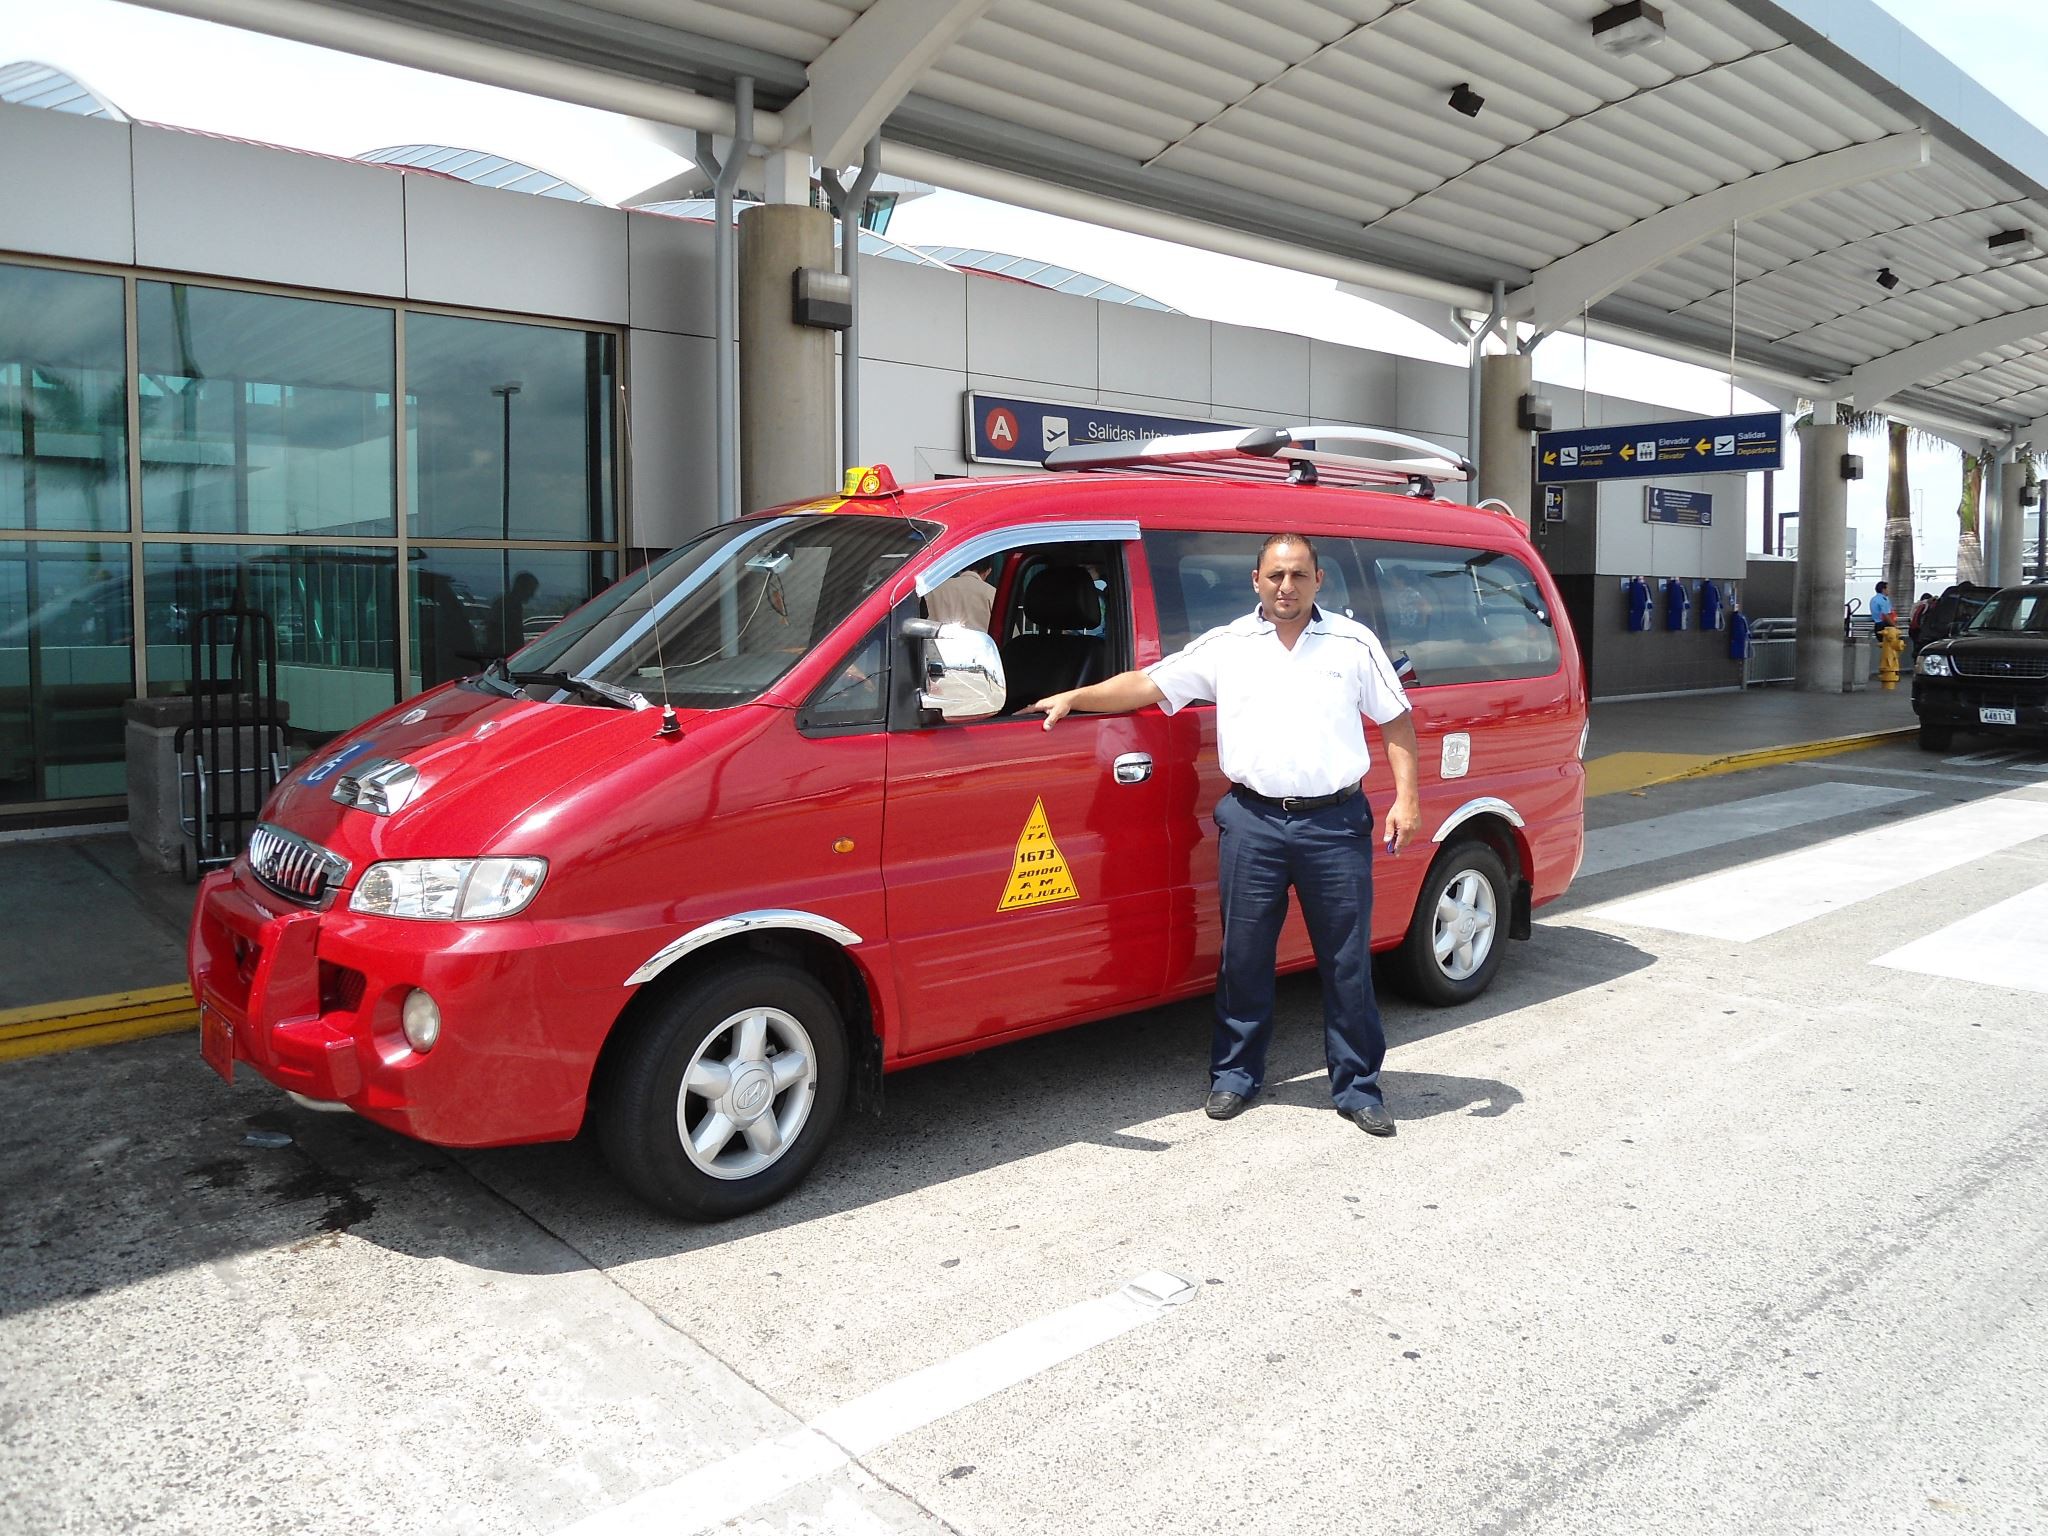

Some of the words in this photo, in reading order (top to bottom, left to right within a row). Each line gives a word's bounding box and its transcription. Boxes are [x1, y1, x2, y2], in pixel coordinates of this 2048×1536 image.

[992, 416, 1013, 441] A
[1087, 421, 1136, 441] Salidas
[1737, 431, 1767, 440] Salidas
[1580, 443, 1611, 453] Llegadas
[1658, 437, 1691, 446] Elevador
[1020, 849, 1054, 863] 1673
[1008, 887, 1071, 902] ALAJUELA
